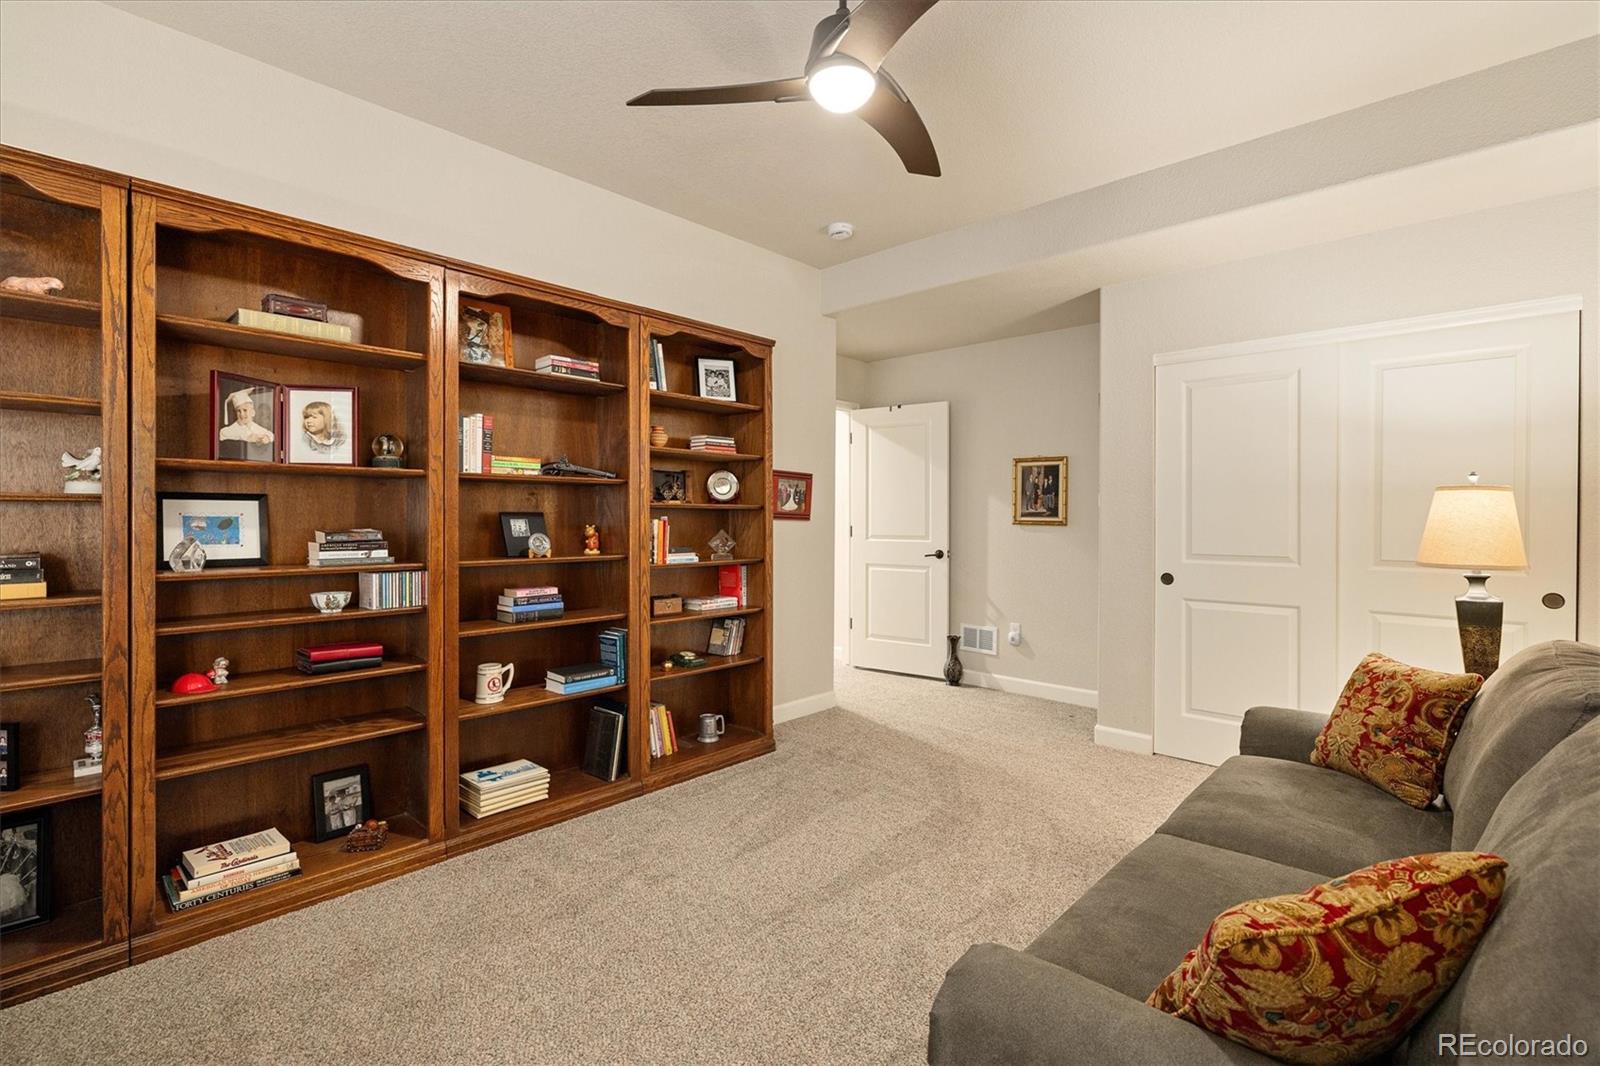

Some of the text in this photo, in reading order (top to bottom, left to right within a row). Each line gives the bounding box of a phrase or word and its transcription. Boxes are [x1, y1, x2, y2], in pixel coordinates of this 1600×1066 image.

[220, 854, 259, 869] The Cardinals
[175, 882, 255, 911] FORTY CENTURIES
